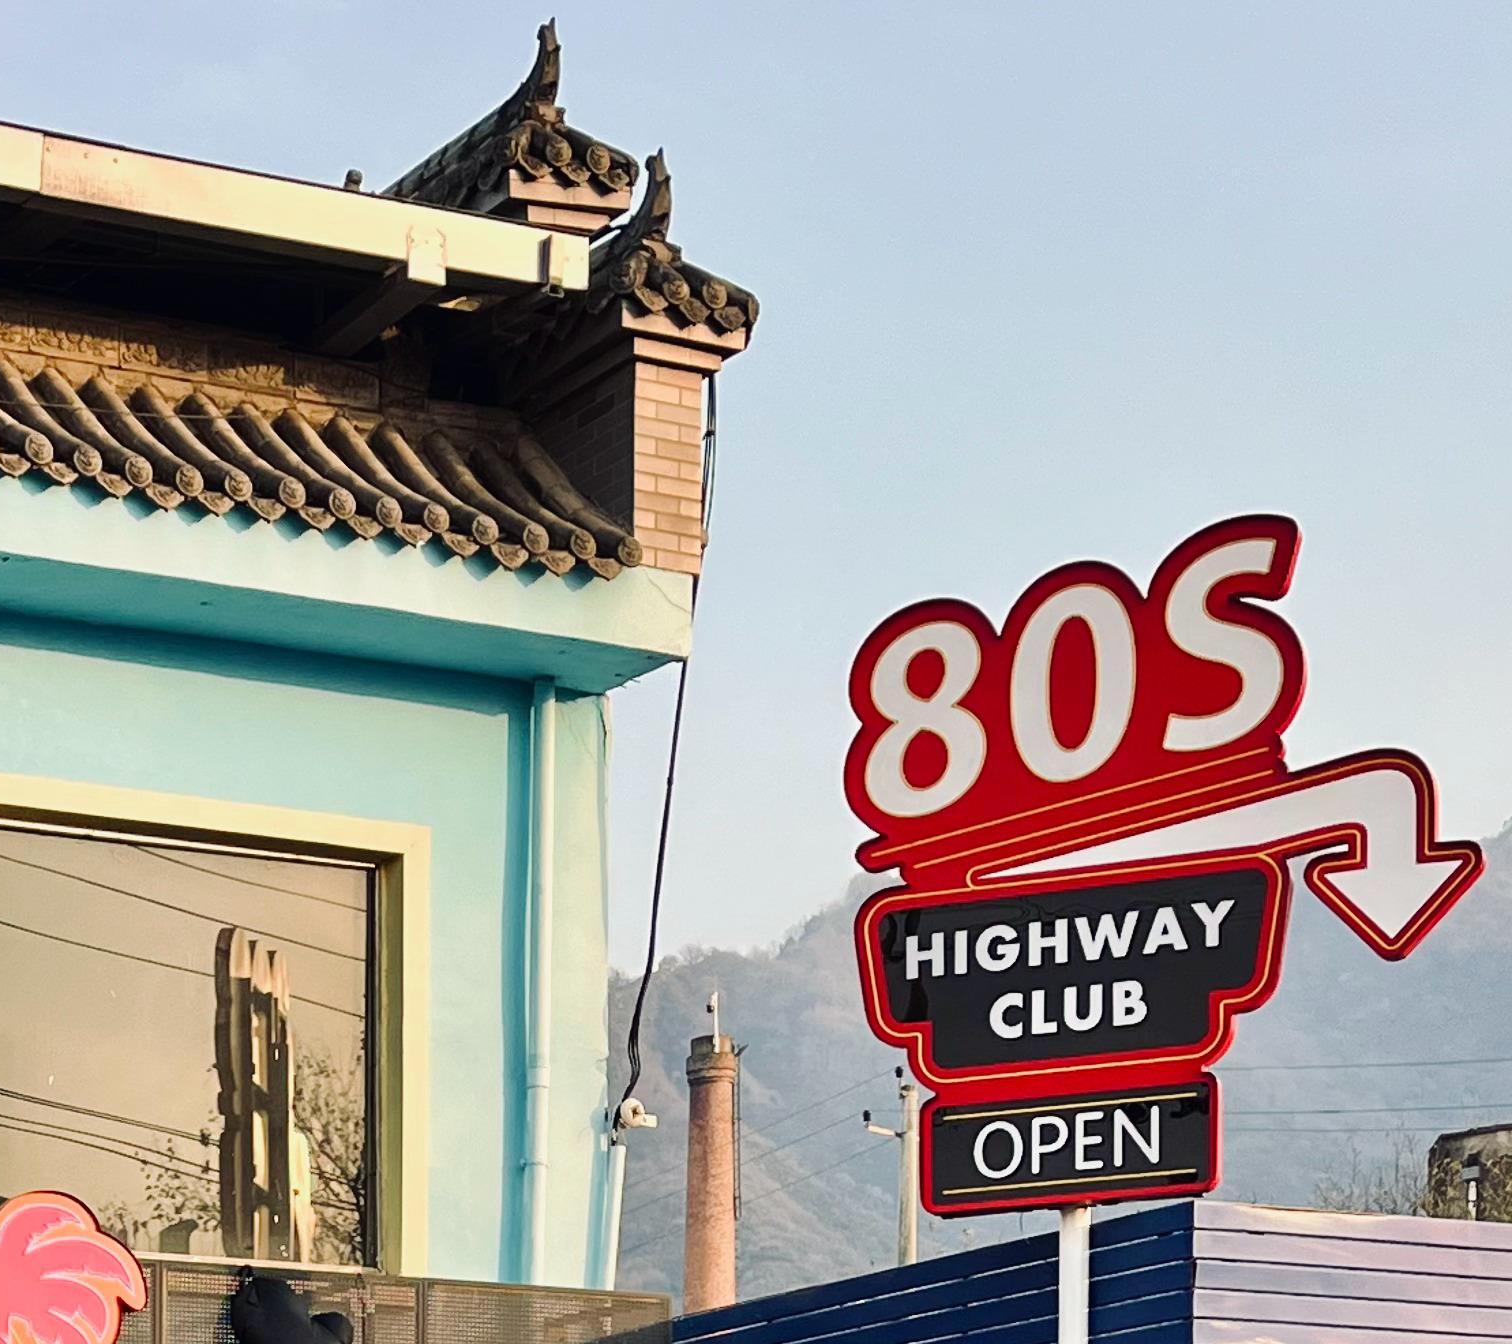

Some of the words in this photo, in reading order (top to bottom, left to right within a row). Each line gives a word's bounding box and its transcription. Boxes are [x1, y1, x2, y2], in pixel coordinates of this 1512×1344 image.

[864, 537, 1284, 818] 80S
[904, 899, 1236, 981] HIGHWAY
[988, 979, 1148, 1039] CLUB
[972, 1105, 1161, 1181] OPEN
